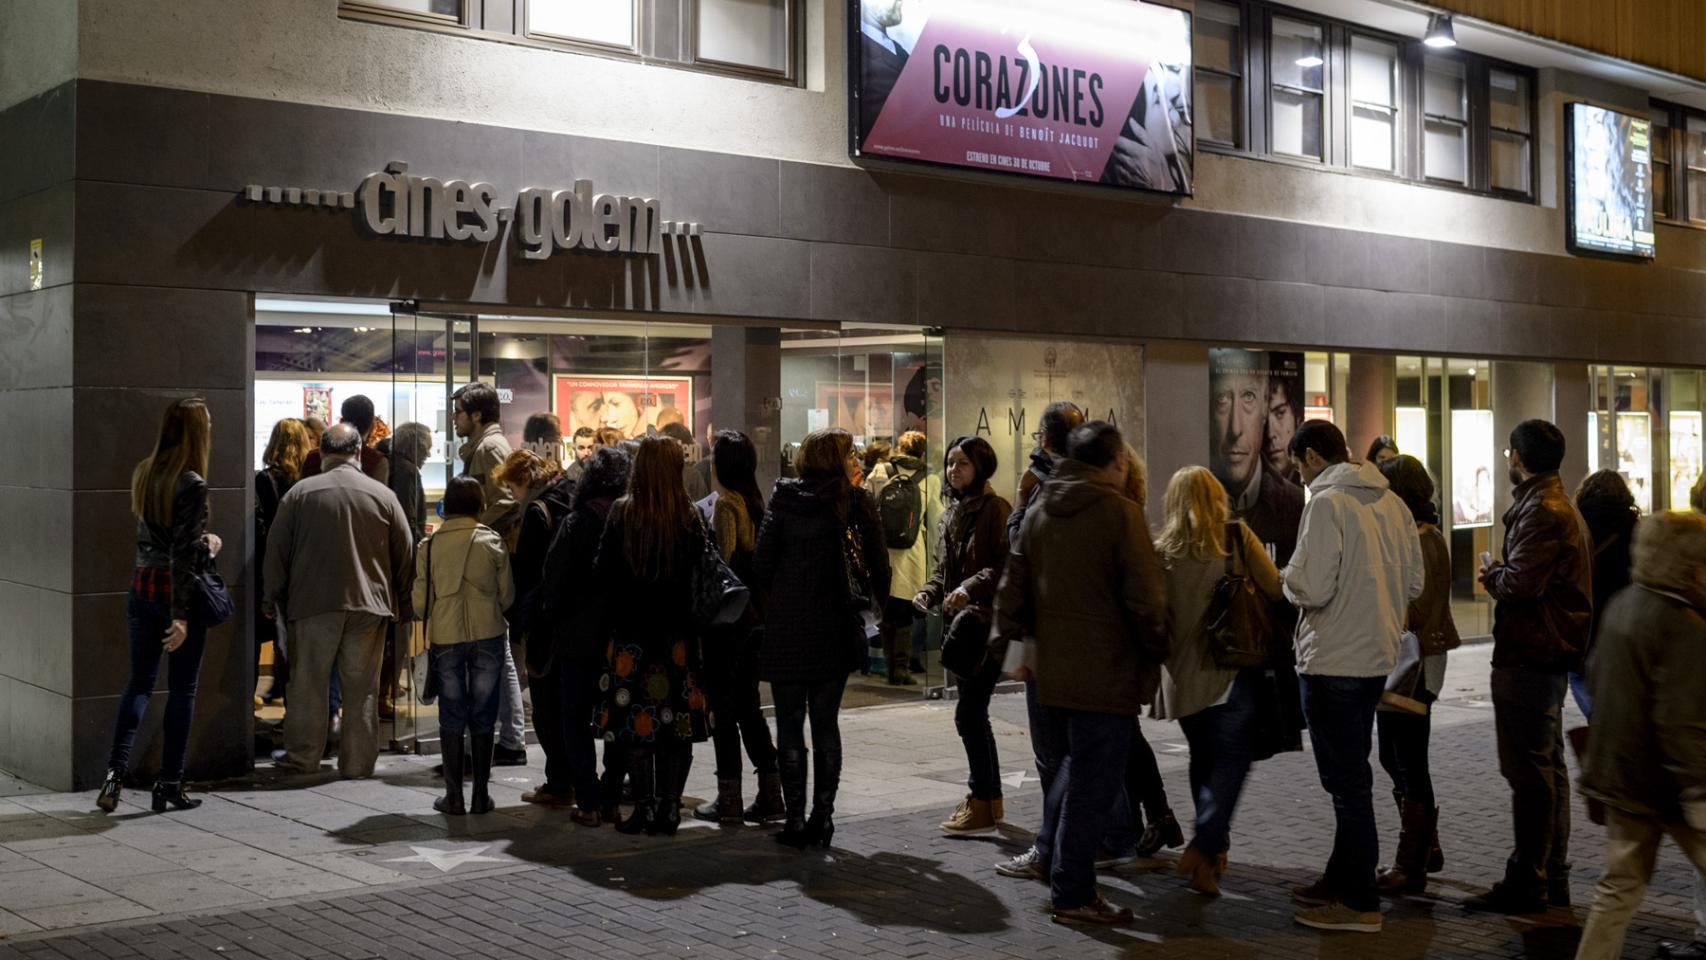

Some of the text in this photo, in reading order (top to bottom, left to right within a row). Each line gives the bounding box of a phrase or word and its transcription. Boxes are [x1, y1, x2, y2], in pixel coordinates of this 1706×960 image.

[933, 43, 1104, 129] CORAZONES
[939, 114, 1099, 149] UNA PELÍCULA DE BENOÎT JACQUOT
[966, 150, 989, 164] ESTRENO
[990, 153, 997, 165] EN
[997, 154, 1012, 167] CINES
[1021, 158, 1028, 169] DE
[1028, 159, 1051, 172] OCTUBRE
[361, 161, 661, 260] cines golem
